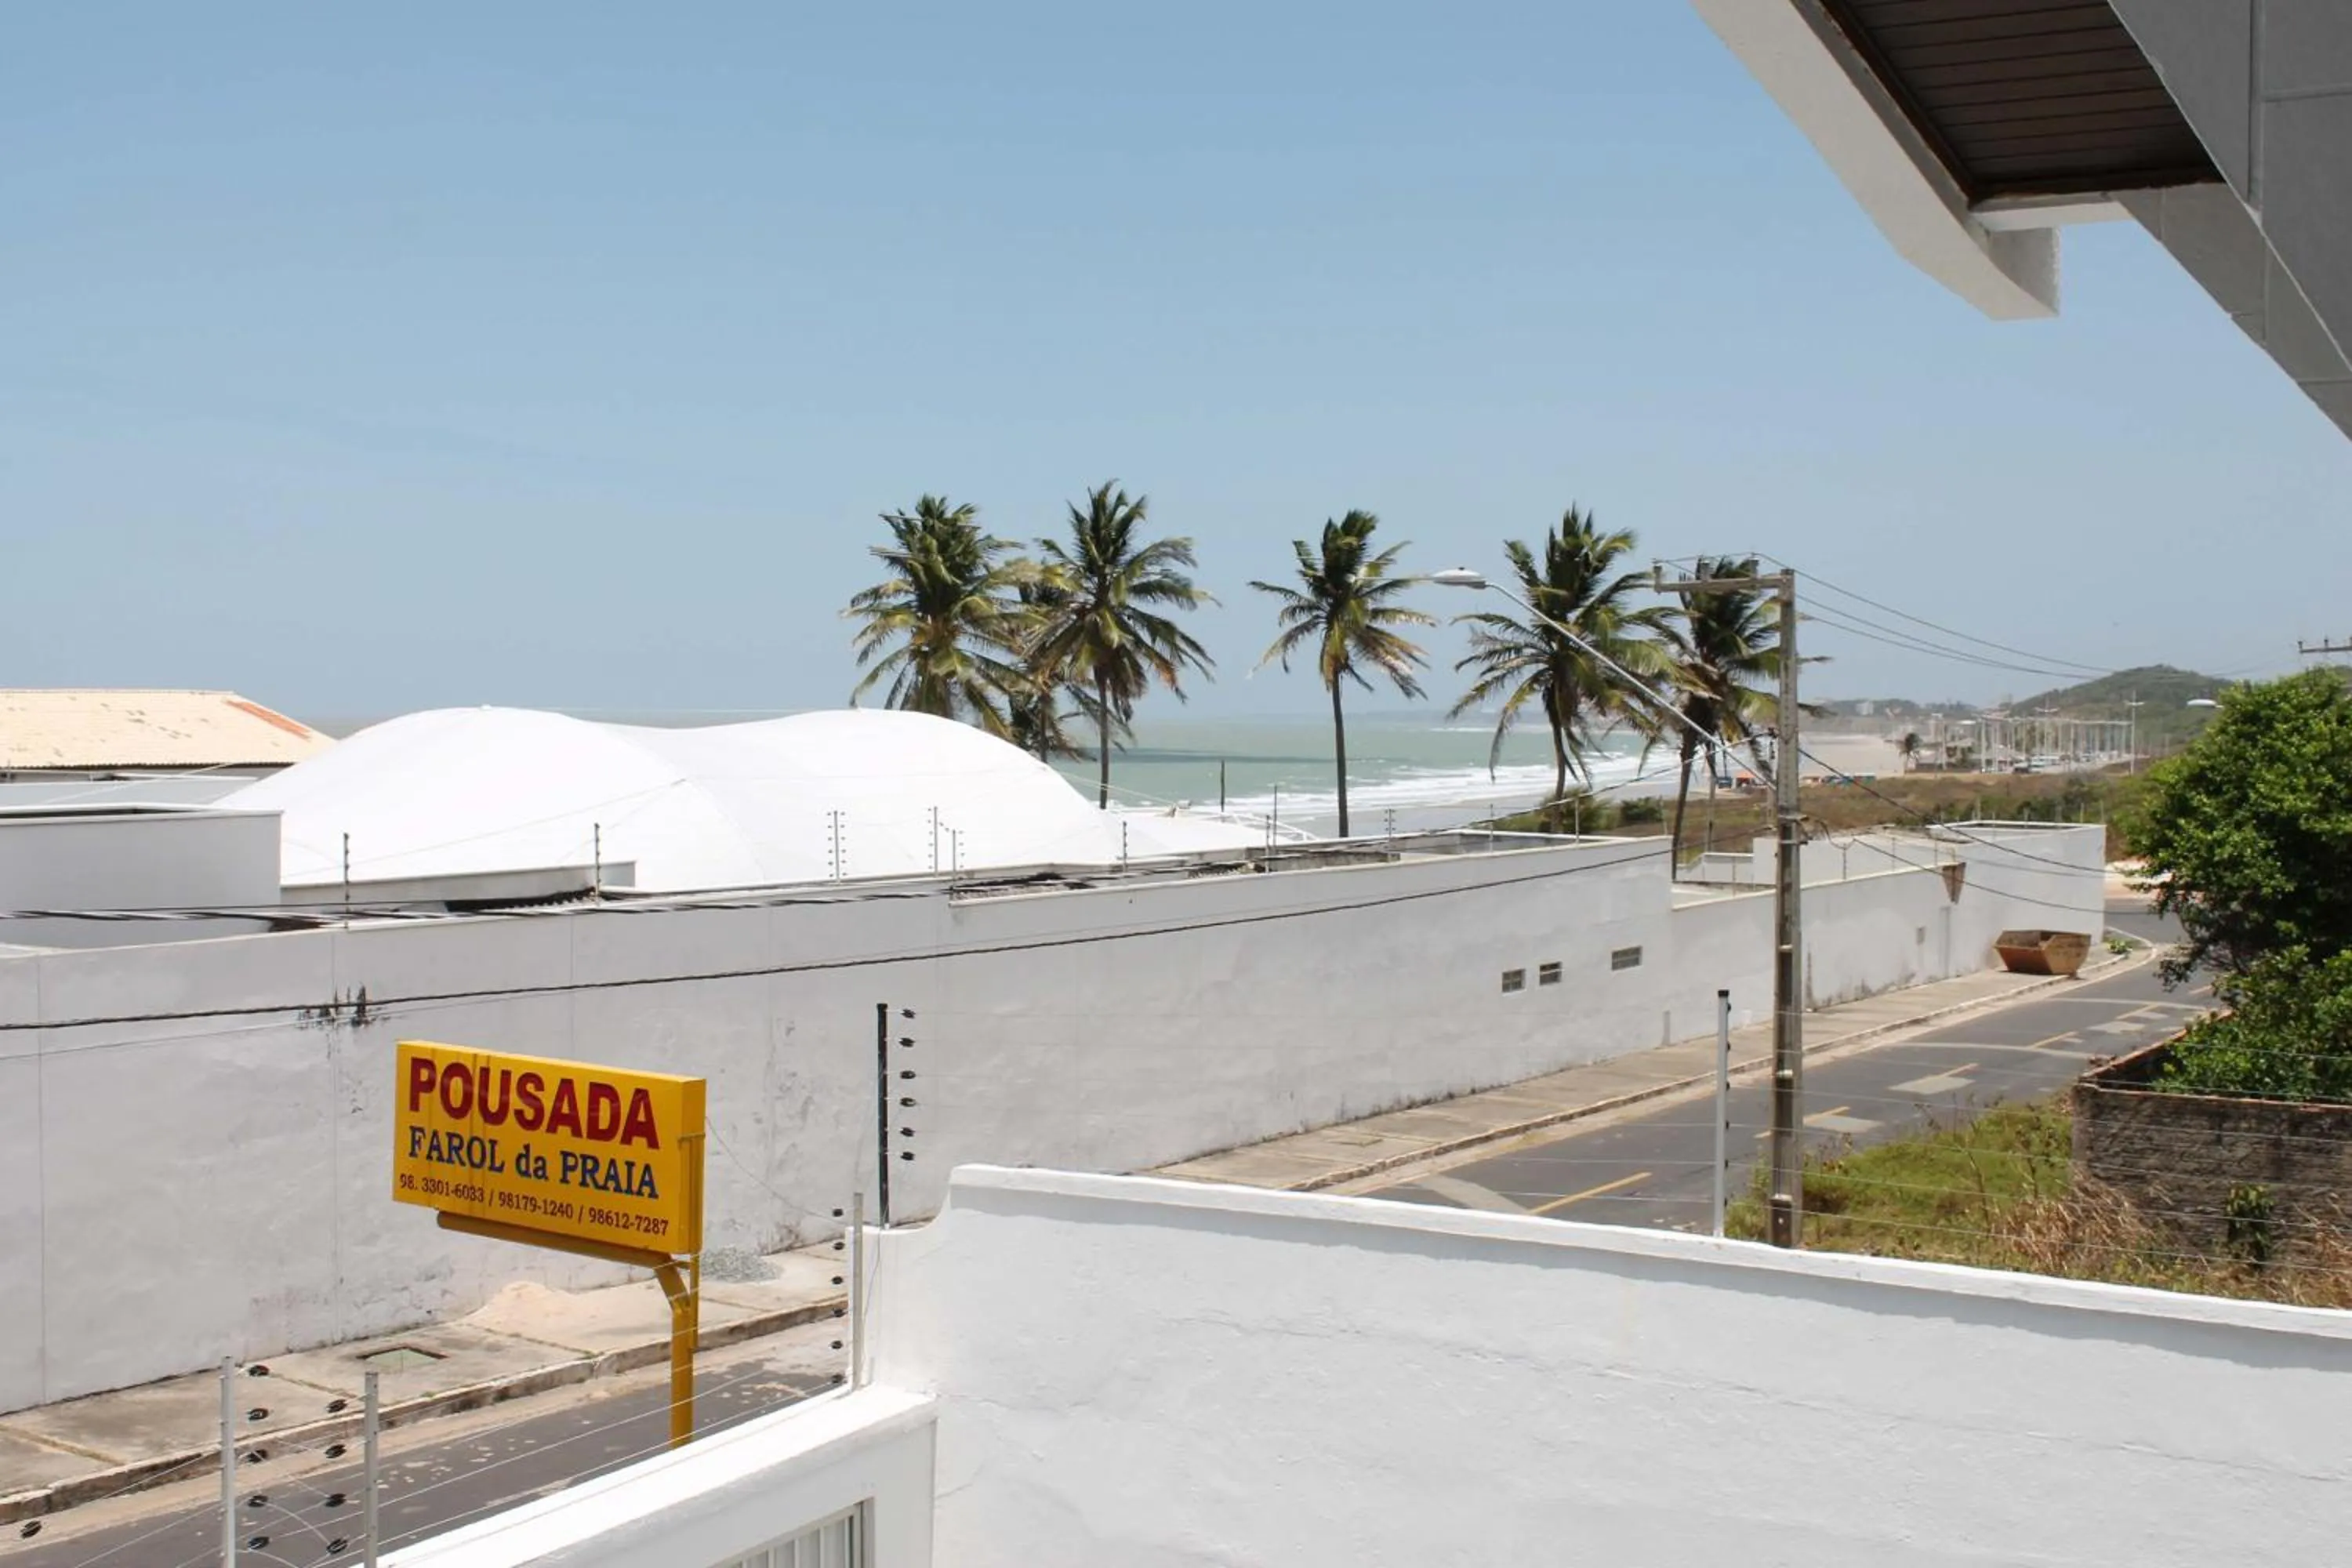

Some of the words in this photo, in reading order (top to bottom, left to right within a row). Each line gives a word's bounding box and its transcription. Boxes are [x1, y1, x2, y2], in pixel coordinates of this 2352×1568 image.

[408, 1057, 660, 1150] POUSADA
[408, 1125, 505, 1173] FAROL
[515, 1143, 549, 1181] da
[560, 1150, 659, 1200] PRAIA
[400, 1174, 417, 1190] 98.
[499, 1191, 574, 1219] 98179-1240
[589, 1207, 669, 1236] 98612-7287
